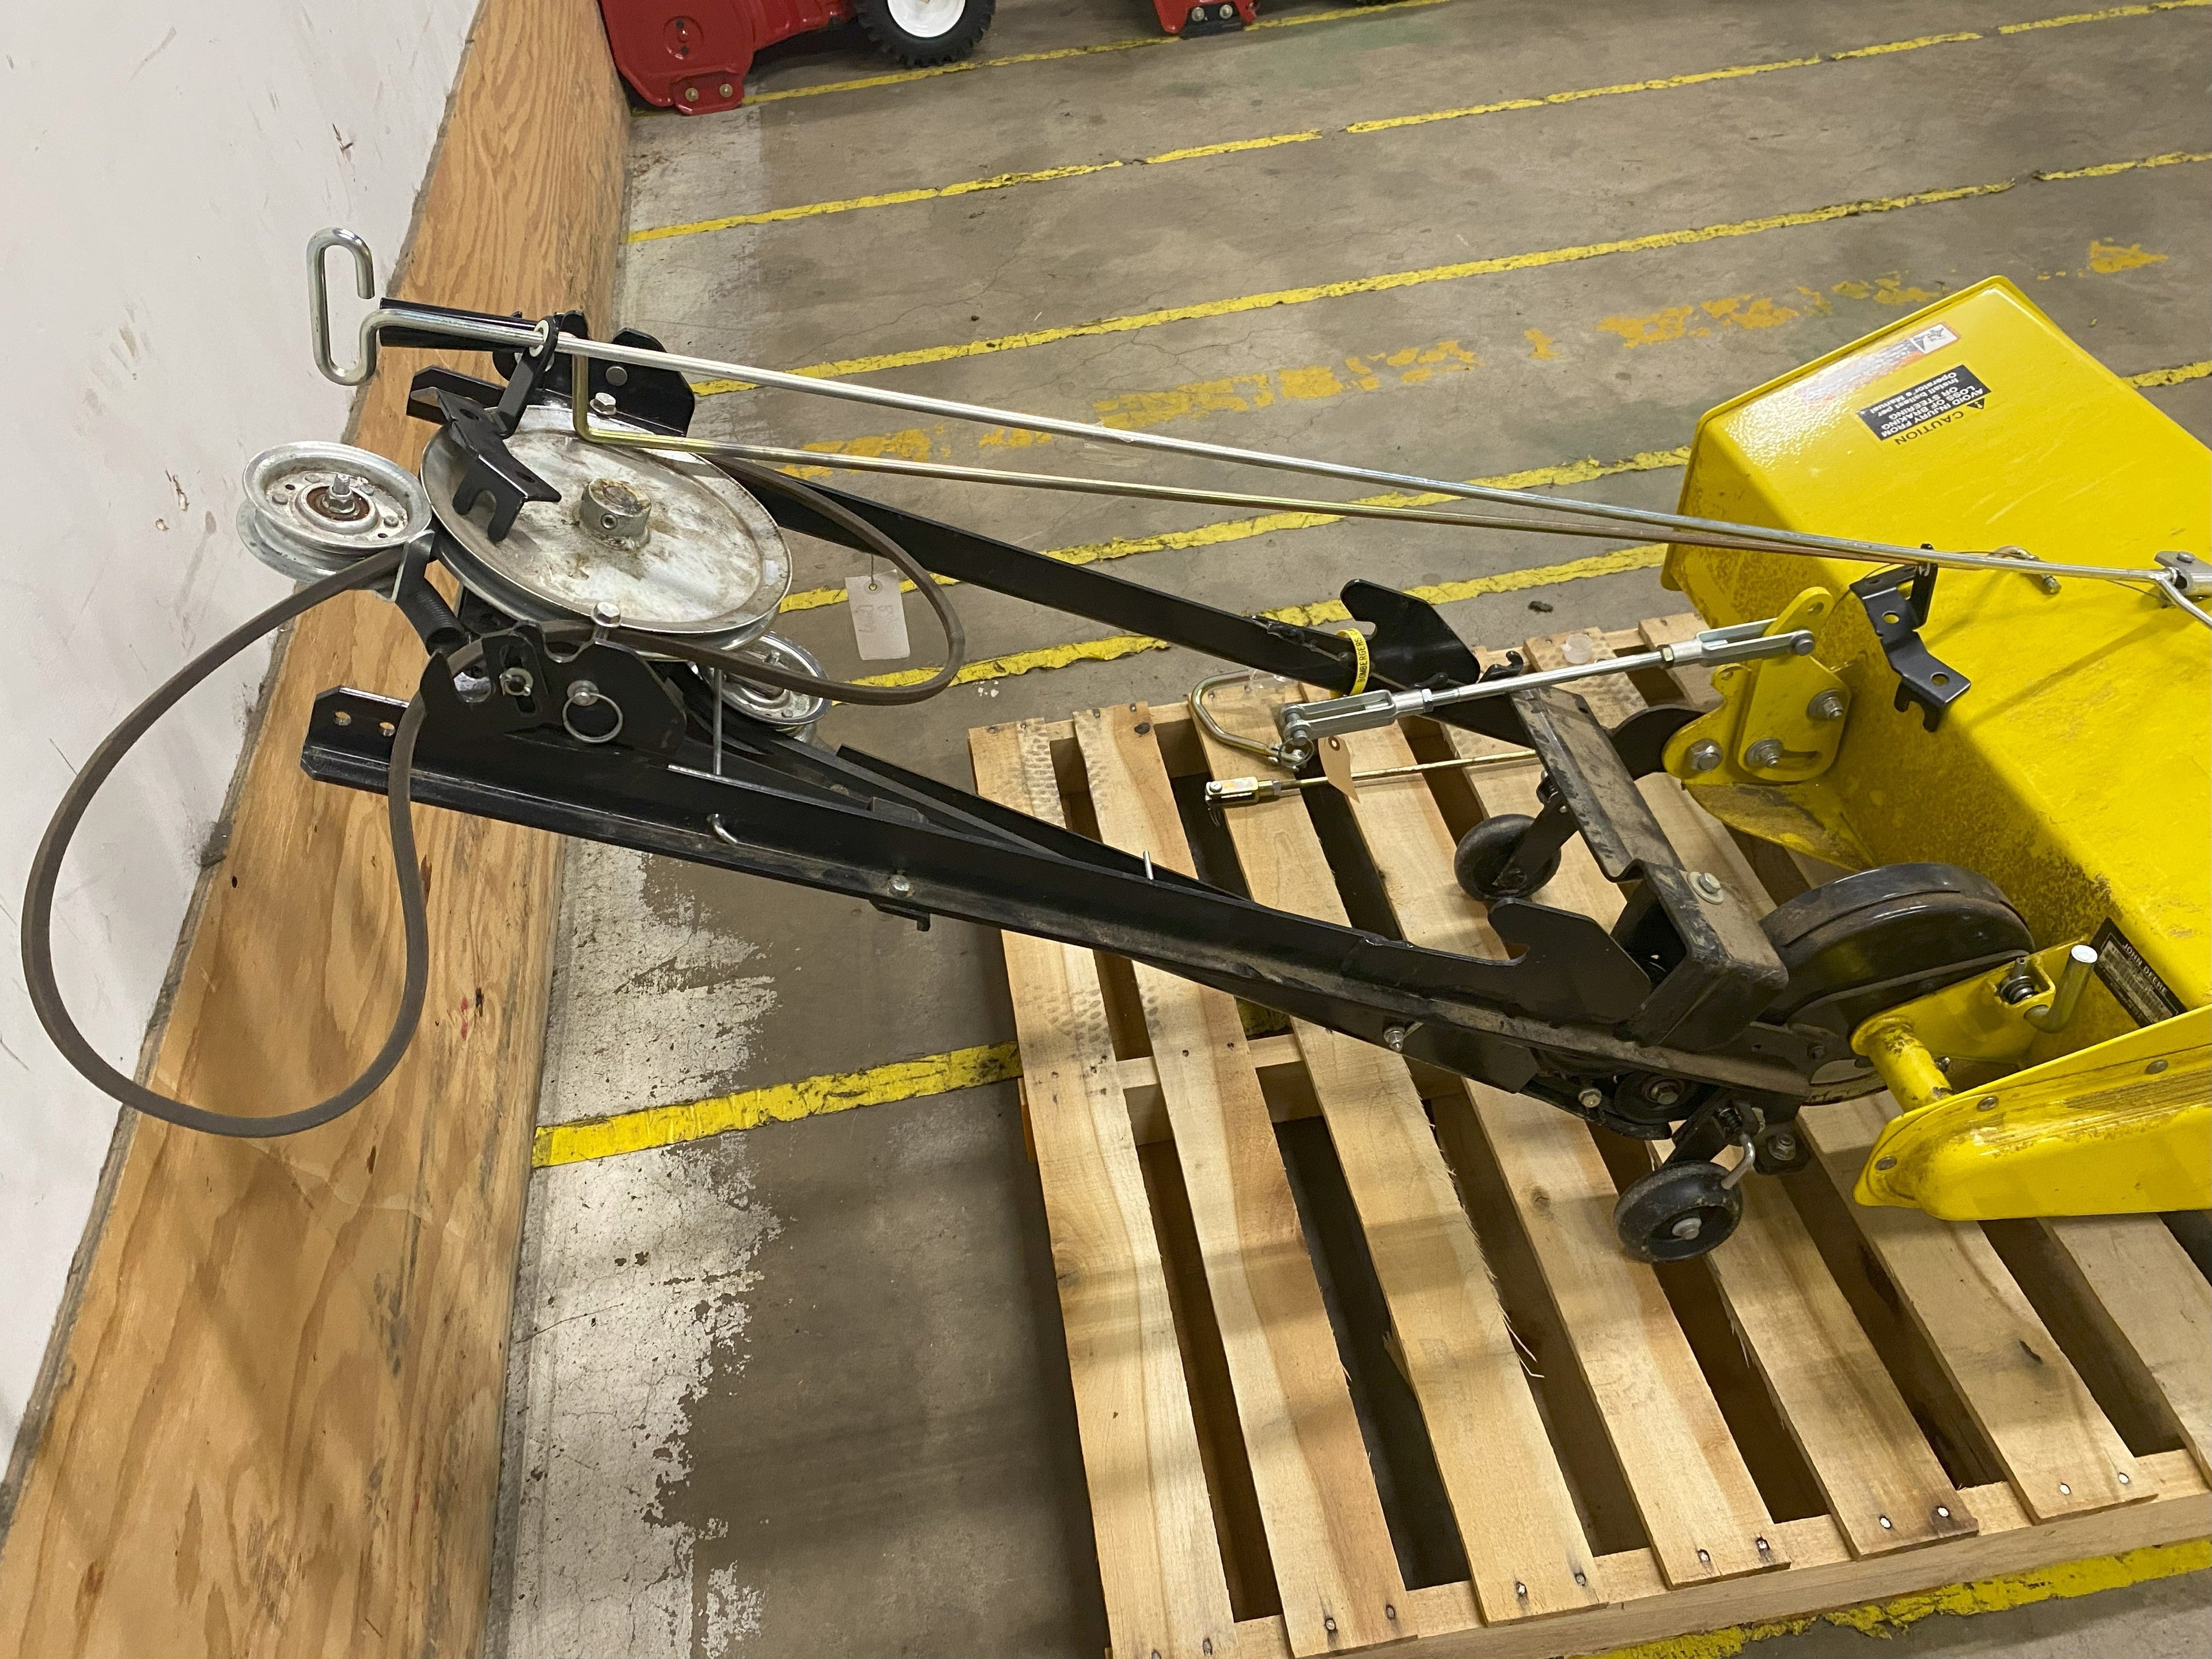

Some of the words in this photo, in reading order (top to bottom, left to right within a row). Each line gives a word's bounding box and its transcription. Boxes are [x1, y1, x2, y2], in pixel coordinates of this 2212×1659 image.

[1929, 377, 1959, 395] Install
[1940, 386, 1959, 397] OR
[1946, 385, 1976, 402] LOSS
[1870, 394, 1906, 414] Manual
[1895, 391, 1928, 410] ballast
[1931, 399, 1946, 410] OF
[1952, 387, 1983, 406] AVOID
[1877, 406, 1894, 418] per
[1888, 394, 1941, 421] STEERING
[1914, 402, 1952, 424] INJURY
[1881, 406, 1929, 430] BRAKING
[1880, 421, 1913, 438] FROM
[1894, 411, 1964, 445] CAUTION
[1354, 637, 1368, 684] BOMBERGERS
[2122, 942, 2143, 967] JOHN
[2143, 966, 2168, 996] DEERE
